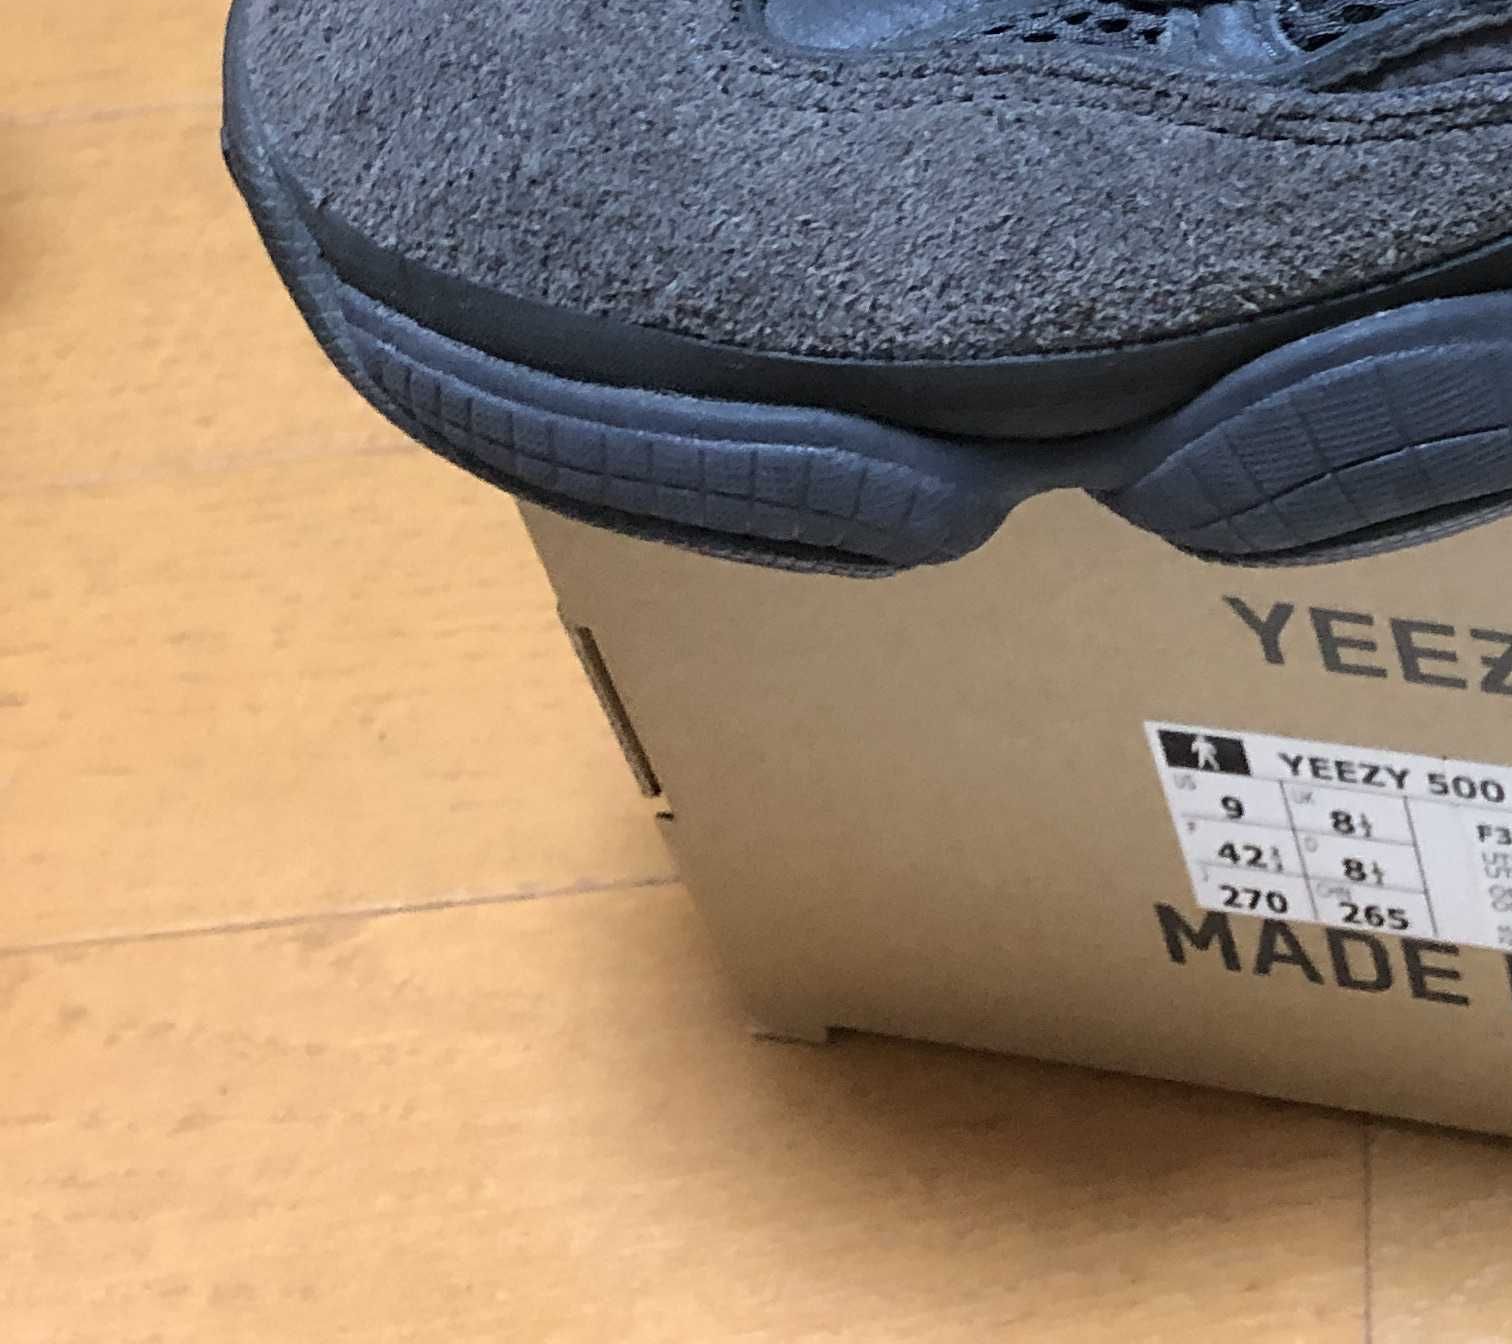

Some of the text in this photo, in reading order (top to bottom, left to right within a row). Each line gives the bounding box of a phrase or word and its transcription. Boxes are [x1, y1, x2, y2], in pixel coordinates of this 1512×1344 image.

[1278, 752, 1505, 803] YEEZY 500
[1220, 795, 1245, 820] 9
[1219, 884, 1289, 914] 270
[1339, 902, 1410, 931] 265
[1154, 902, 1469, 1008] MADE
